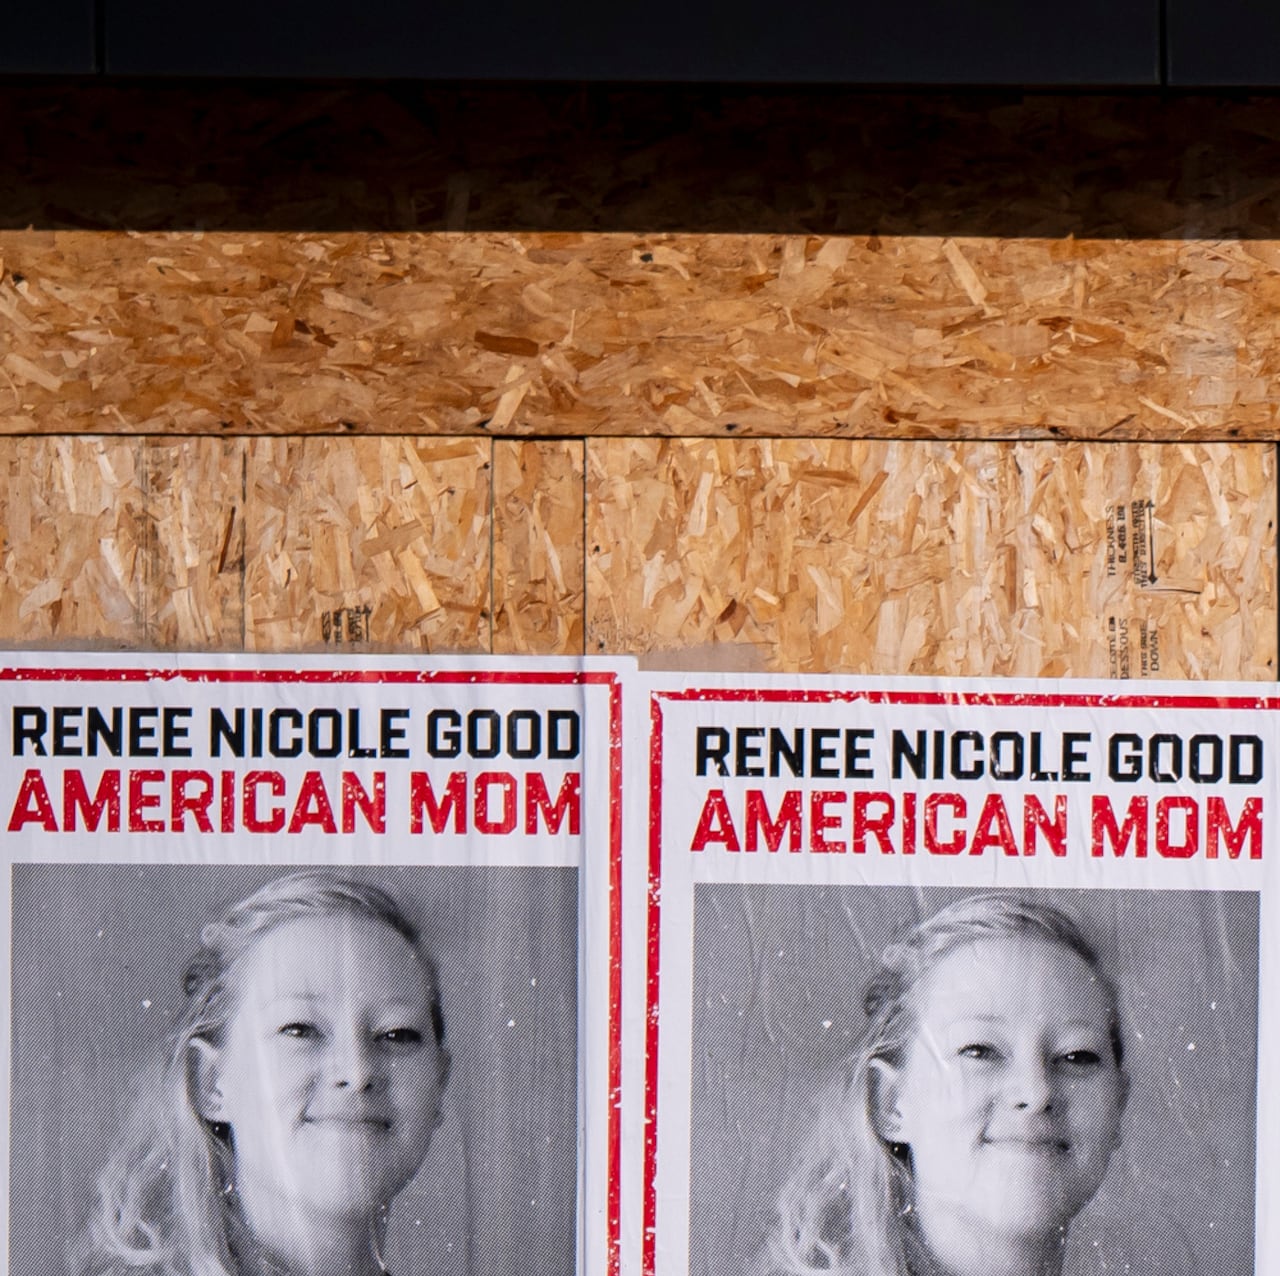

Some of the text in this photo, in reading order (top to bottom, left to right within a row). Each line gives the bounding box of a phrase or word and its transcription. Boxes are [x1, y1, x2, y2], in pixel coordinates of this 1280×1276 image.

[1105, 505, 1116, 577] THICKNESS
[13, 707, 580, 759] RENEE NICOLE GOOD
[696, 727, 1262, 784] RENEE NICOLE GOOD
[8, 769, 580, 835] AMERICAN MOM
[691, 789, 1263, 859] AMERICAN MOM
